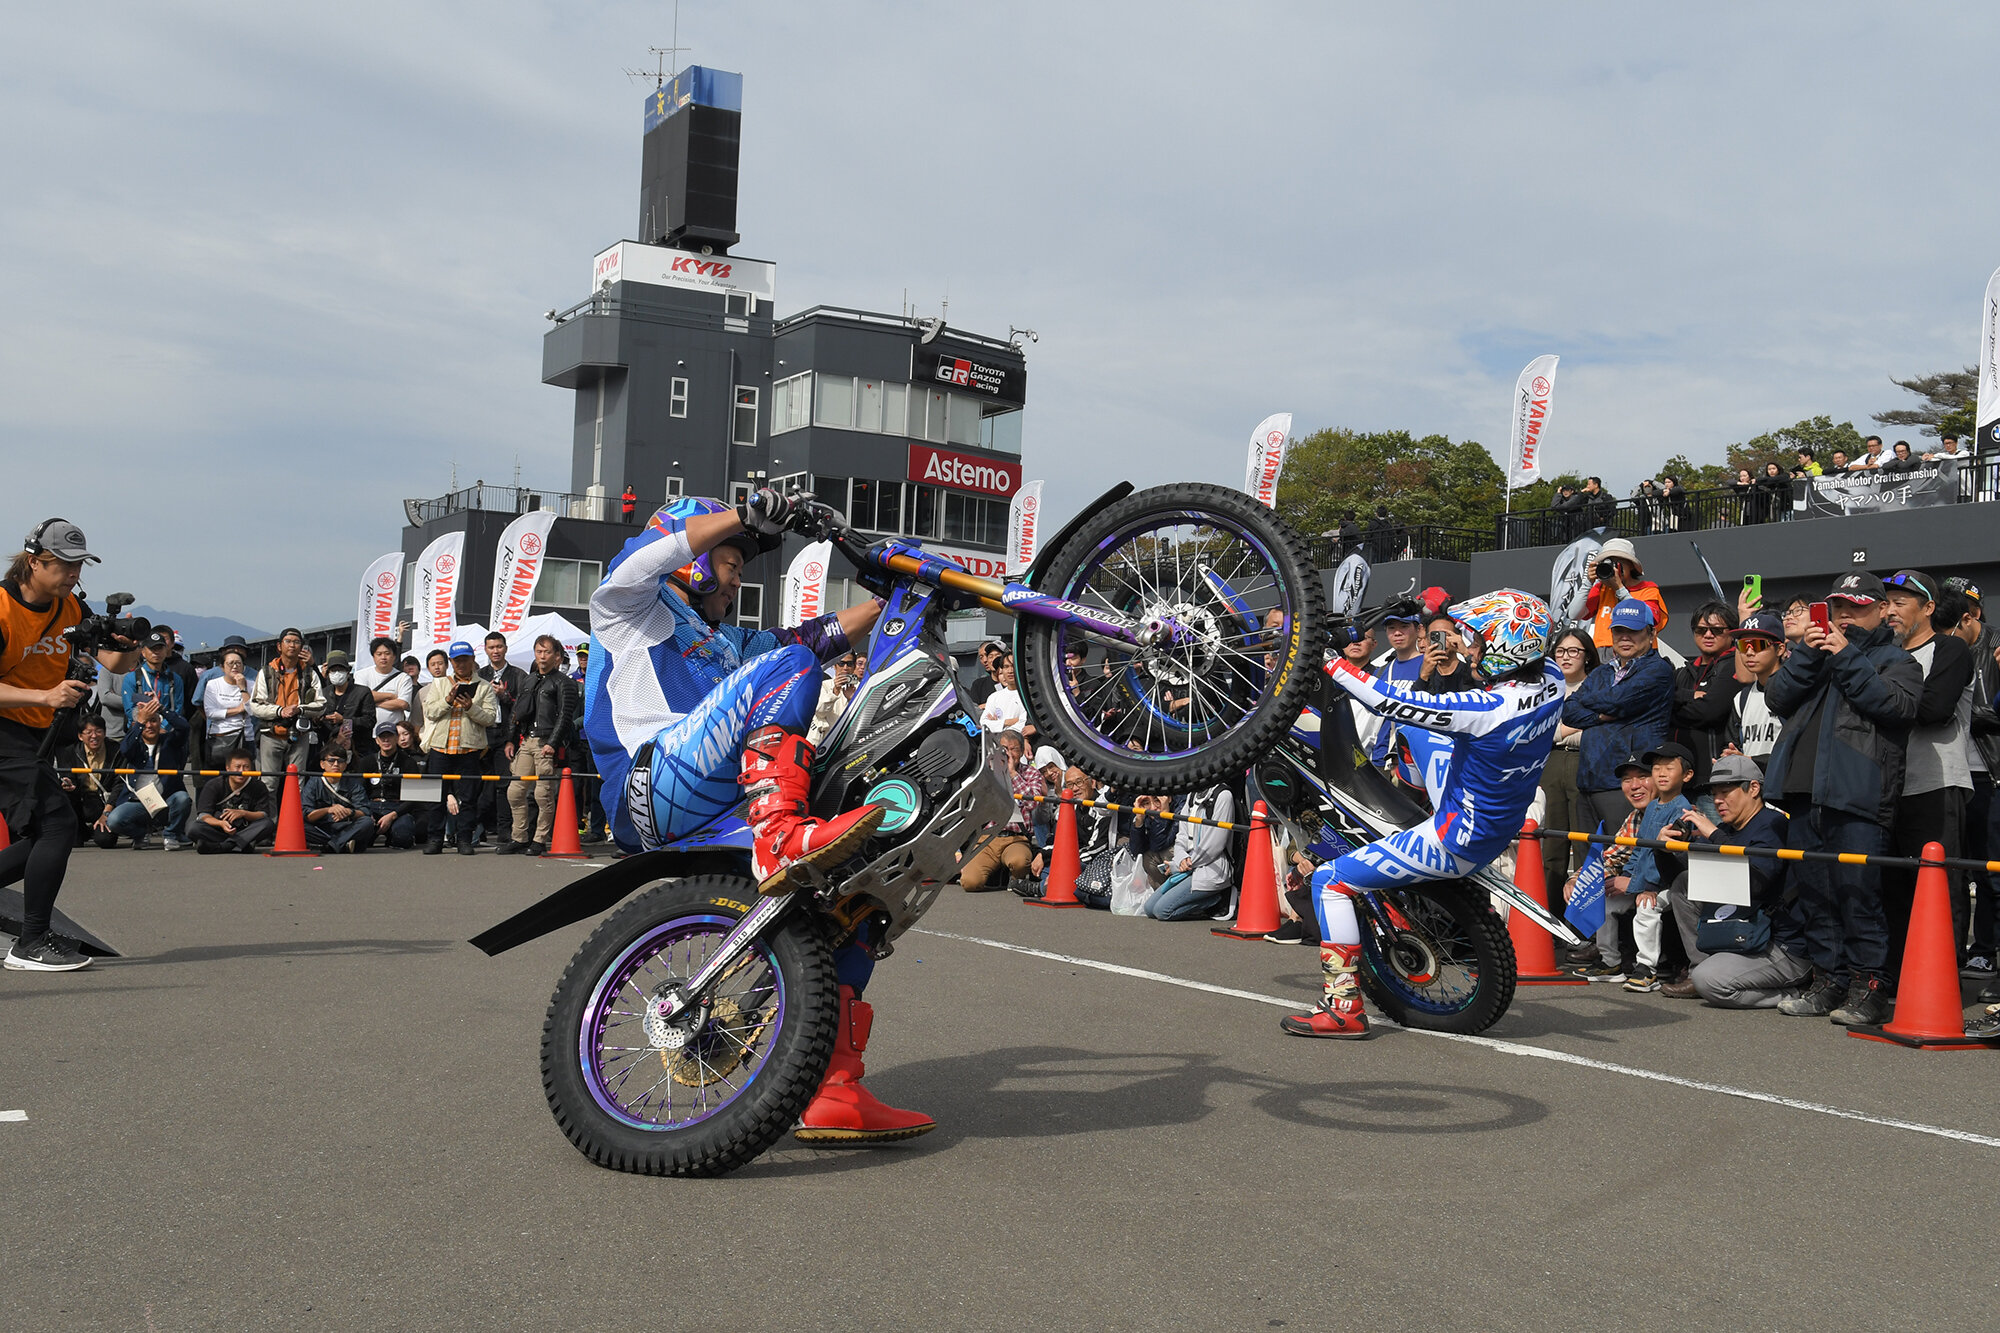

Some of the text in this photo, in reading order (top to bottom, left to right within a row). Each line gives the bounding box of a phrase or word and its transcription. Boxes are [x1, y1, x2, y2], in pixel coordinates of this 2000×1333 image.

[598, 252, 618, 275] KYB
[671, 256, 732, 278] KYB
[672, 275, 696, 284] Precision,
[711, 281, 737, 290] Advantage
[937, 365, 968, 384] GR
[970, 371, 1002, 385] GAZOO
[972, 363, 1006, 378] TOYOTA
[969, 380, 999, 394] Racing
[1522, 399, 1548, 470] YAMAHA
[924, 452, 1011, 492] Astemo
[1812, 467, 1938, 491] Yamaha Motor Craftsmanship
[1835, 484, 1913, 511] ヤマハの手
[1019, 512, 1035, 564] YAMAHA
[938, 553, 1007, 579] NDA
[1853, 551, 1866, 562] 22
[499, 558, 538, 633] YAMAHA
[800, 583, 820, 623] YAM
[374, 592, 393, 638] YAMA
[433, 575, 454, 645] YAMAHA
[1056, 600, 1138, 628] DUNLOP
[1273, 619, 1301, 698] DUNLOP
[1515, 638, 1541, 655] Arai
[768, 672, 803, 715] KUSHITANI
[1516, 683, 1558, 711] MOTS
[1374, 699, 1453, 727] MOTS
[1385, 829, 1460, 876] MAHA
[715, 896, 751, 913] DUN
[732, 930, 749, 946] DID
